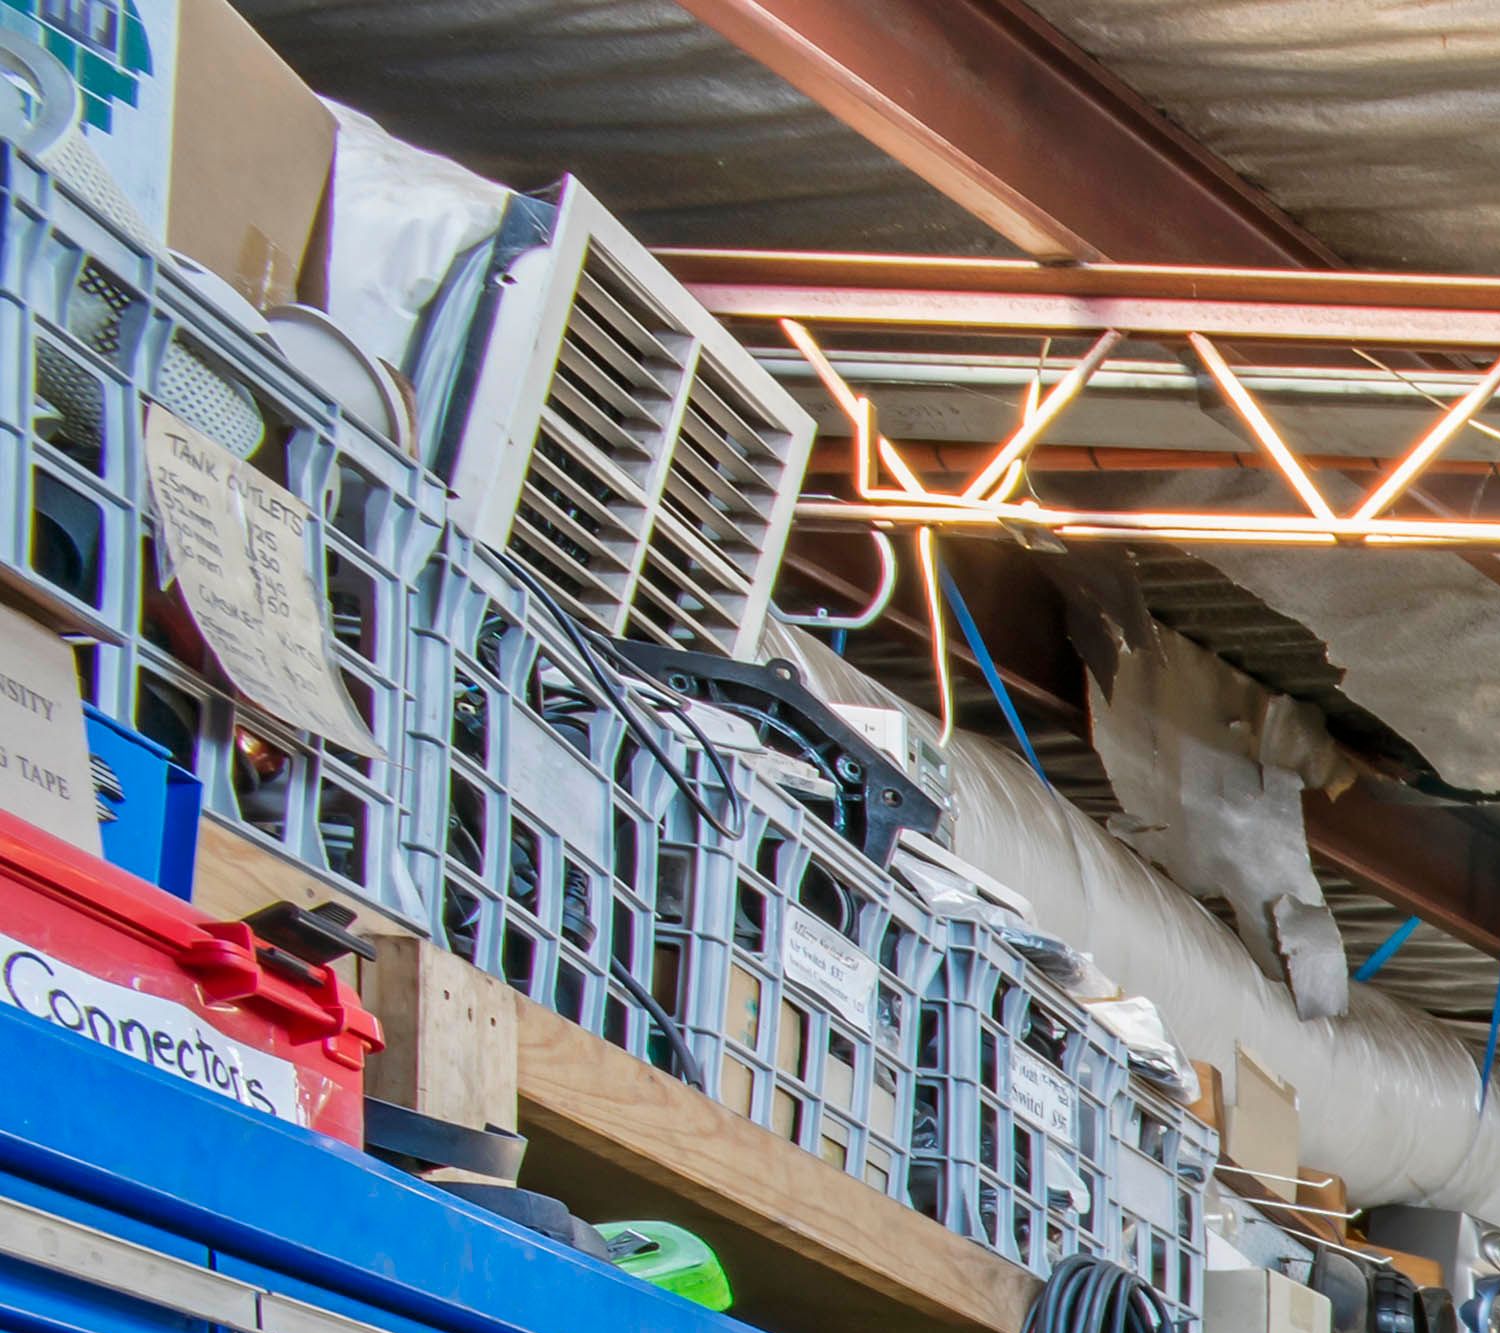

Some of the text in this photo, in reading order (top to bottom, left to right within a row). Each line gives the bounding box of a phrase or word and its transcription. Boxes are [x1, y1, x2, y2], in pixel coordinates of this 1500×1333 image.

[164, 431, 303, 538] TANK OUTLETS
[16, 755, 71, 801] TAPE
[3, 951, 277, 1116] Connectors
